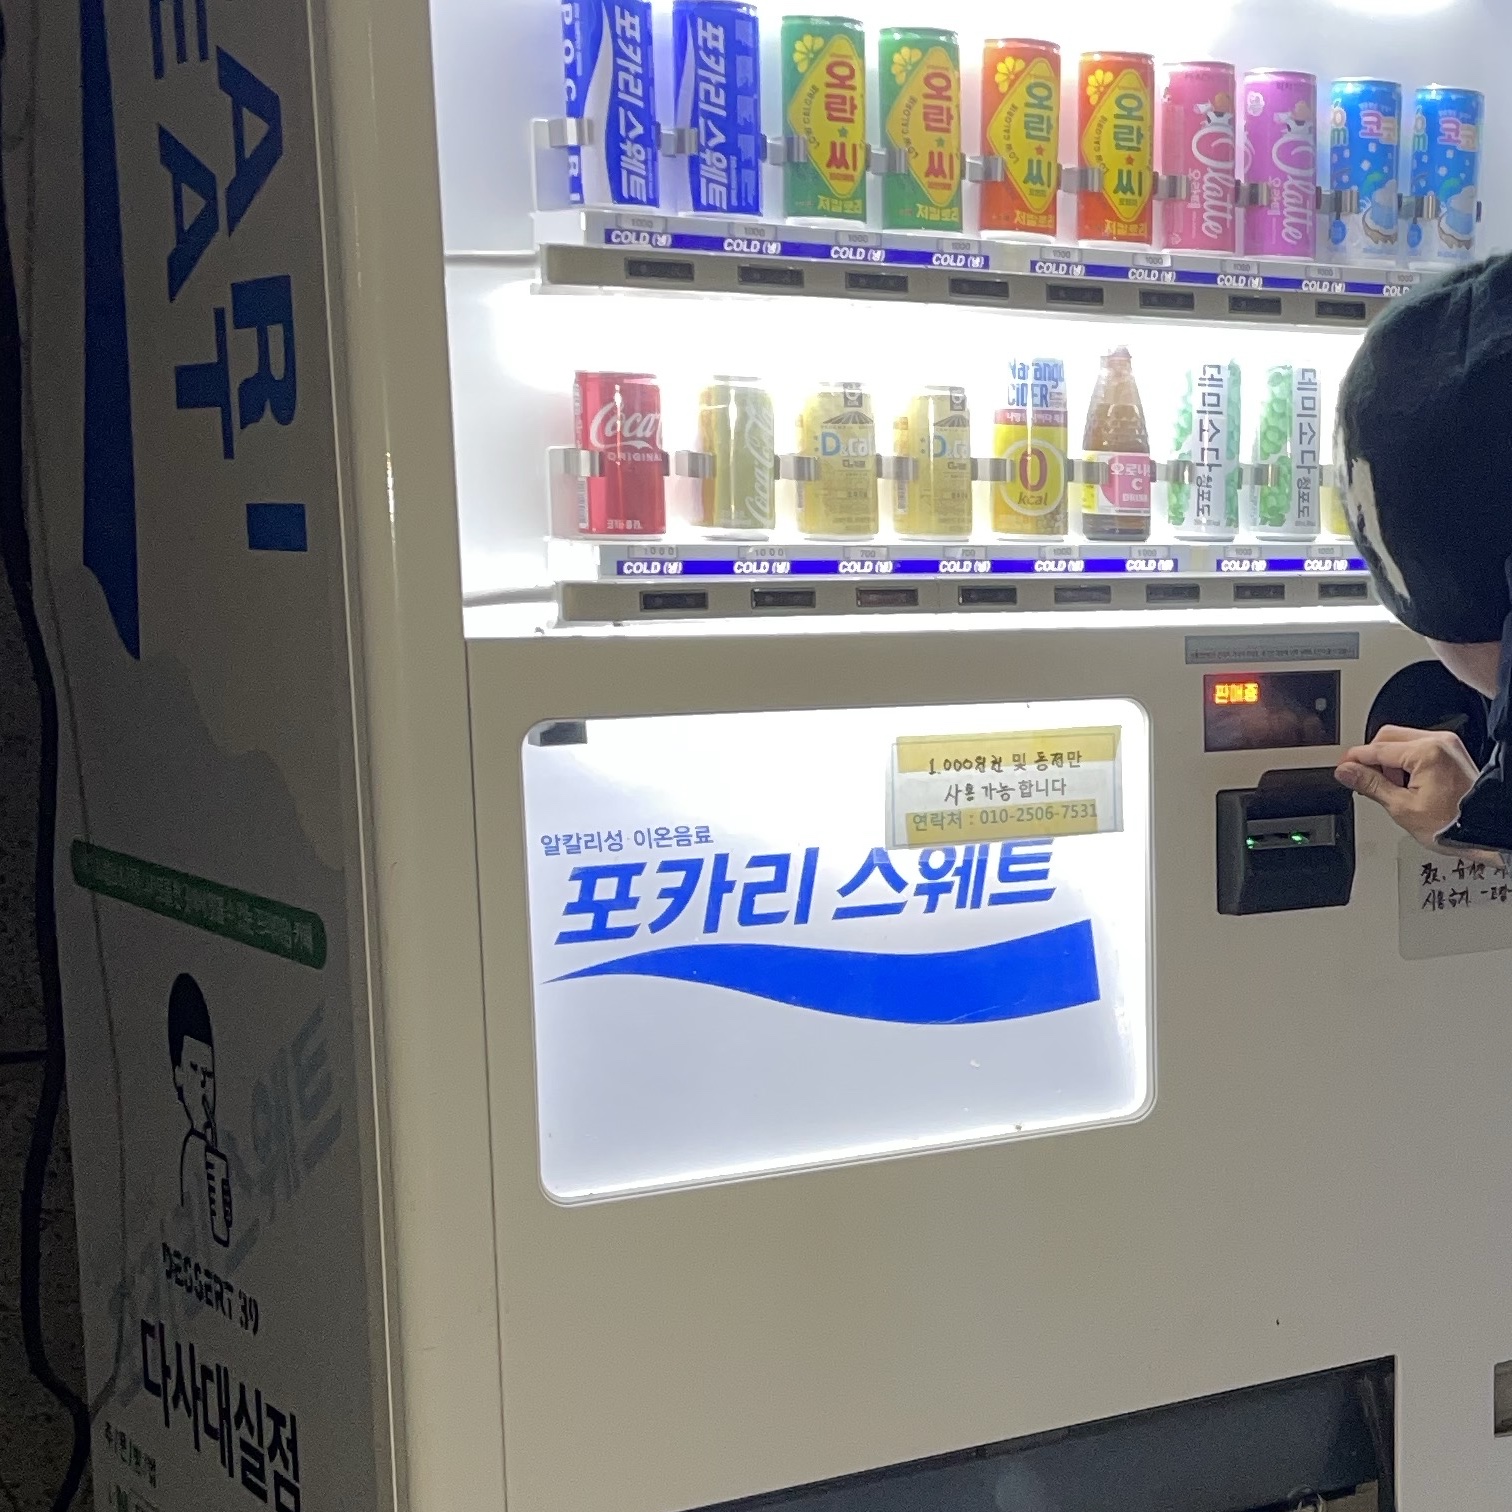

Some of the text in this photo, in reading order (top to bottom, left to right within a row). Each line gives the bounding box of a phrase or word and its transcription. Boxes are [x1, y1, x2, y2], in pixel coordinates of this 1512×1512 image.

[611, 230, 649, 243] COLD
[724, 239, 760, 253] COLD
[830, 246, 865, 260] COLD
[932, 253, 965, 266] COLD
[1035, 262, 1067, 274] COLD
[1128, 269, 1158, 281] COLD
[1217, 275, 1246, 287] COLD
[1302, 280, 1328, 292] COLD
[1195, 364, 1224, 472] 데미소다
[1296, 368, 1318, 474] 데미소다
[1019, 448, 1047, 492] 0
[1017, 492, 1048, 506] kcal
[755, 548, 784, 557] 1000
[623, 562, 660, 574] COLD
[733, 562, 769, 575] COLD
[839, 561, 873, 573] COLD
[1012, 753, 1027, 771] 및
[1034, 750, 1082, 771] 동전만
[913, 811, 962, 832] 연락처
[980, 803, 1097, 824] 010-2506-7531
[540, 825, 714, 857] 알칼리성 이온음료
[554, 836, 1057, 945] 포카리 스웨트
